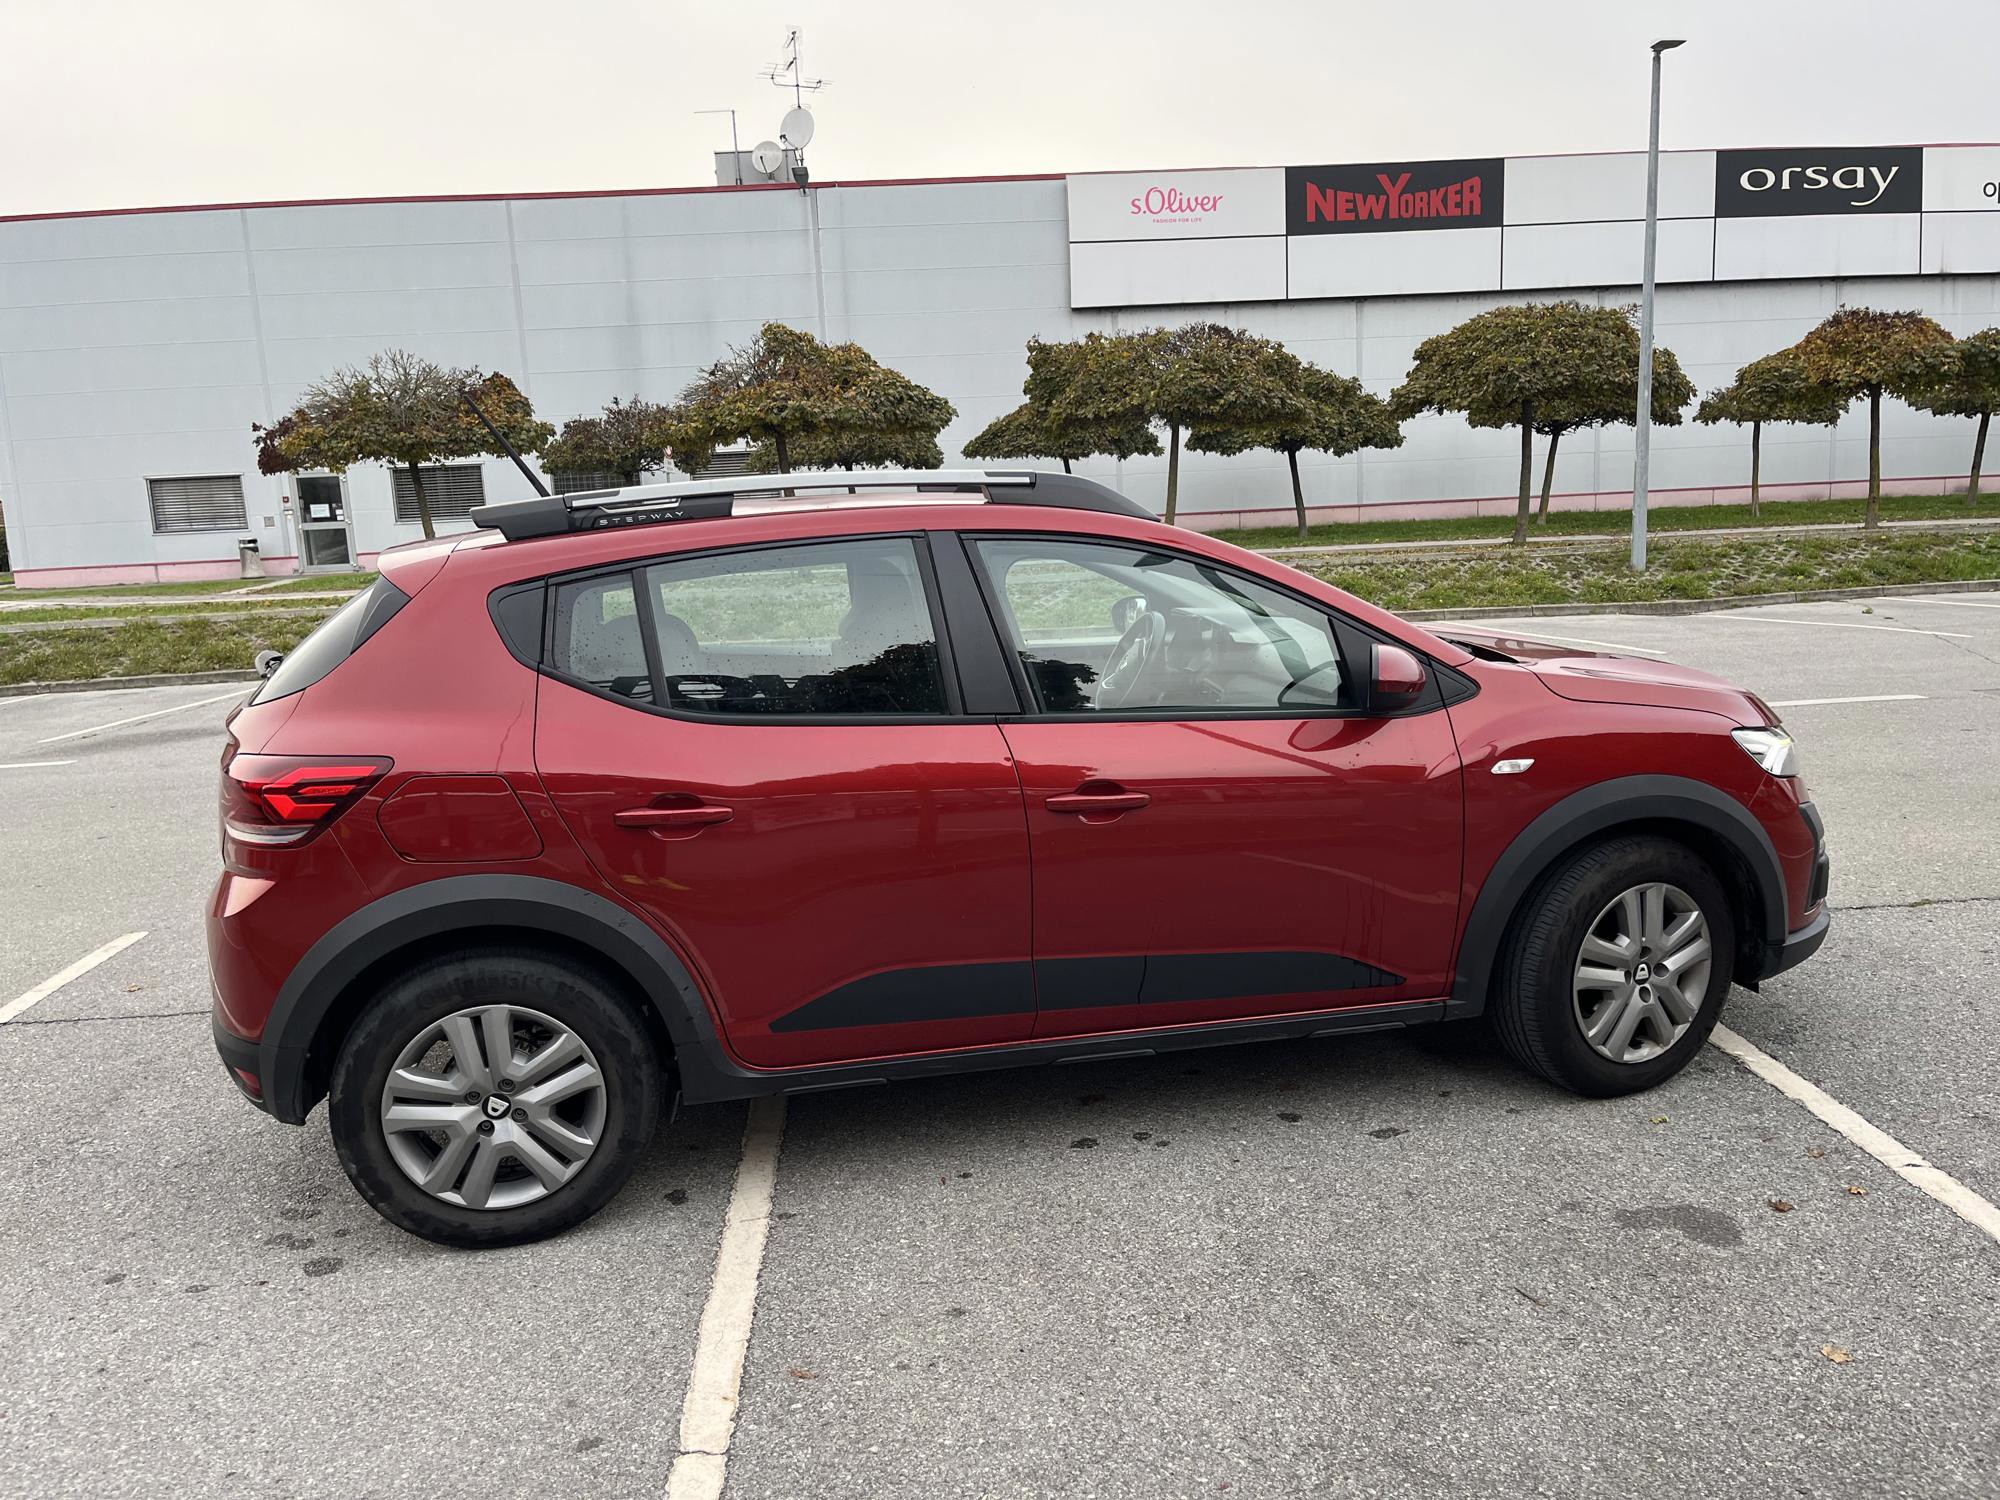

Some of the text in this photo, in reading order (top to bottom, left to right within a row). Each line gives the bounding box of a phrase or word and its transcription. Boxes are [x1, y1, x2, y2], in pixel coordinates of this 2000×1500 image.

[1130, 186, 1223, 214] s.Oliver
[1739, 166, 1900, 206] orsay
[599, 511, 683, 526] STEPWAY
